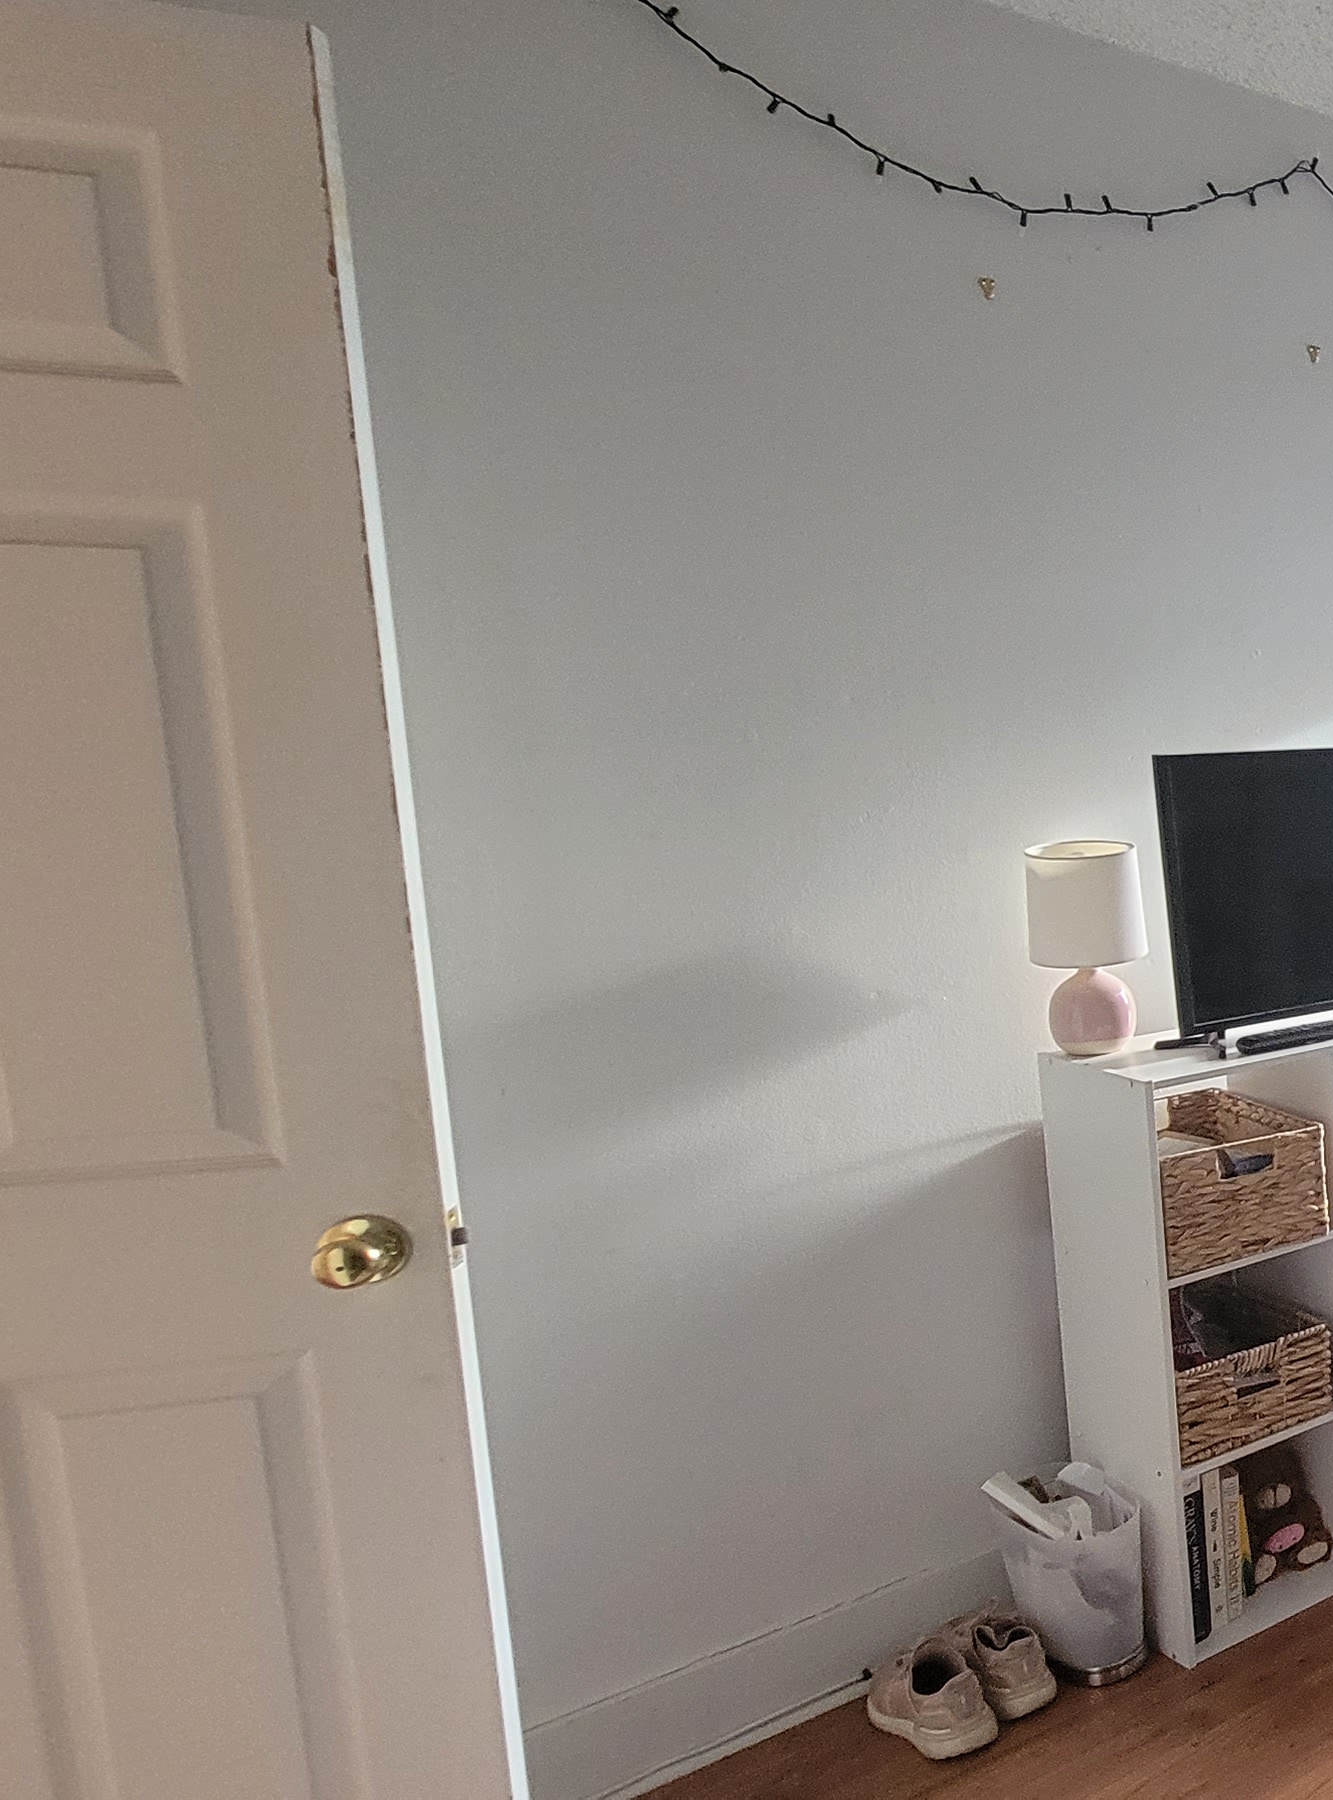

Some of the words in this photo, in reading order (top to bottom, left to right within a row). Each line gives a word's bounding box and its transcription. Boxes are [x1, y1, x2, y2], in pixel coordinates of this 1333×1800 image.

[1209, 1507, 1219, 1533] Wine
[1226, 1501, 1238, 1547] Atomic
[1191, 1546, 1202, 1590] ANATOMY
[1212, 1558, 1222, 1589] Simple
[1228, 1551, 1241, 1593] Habits
